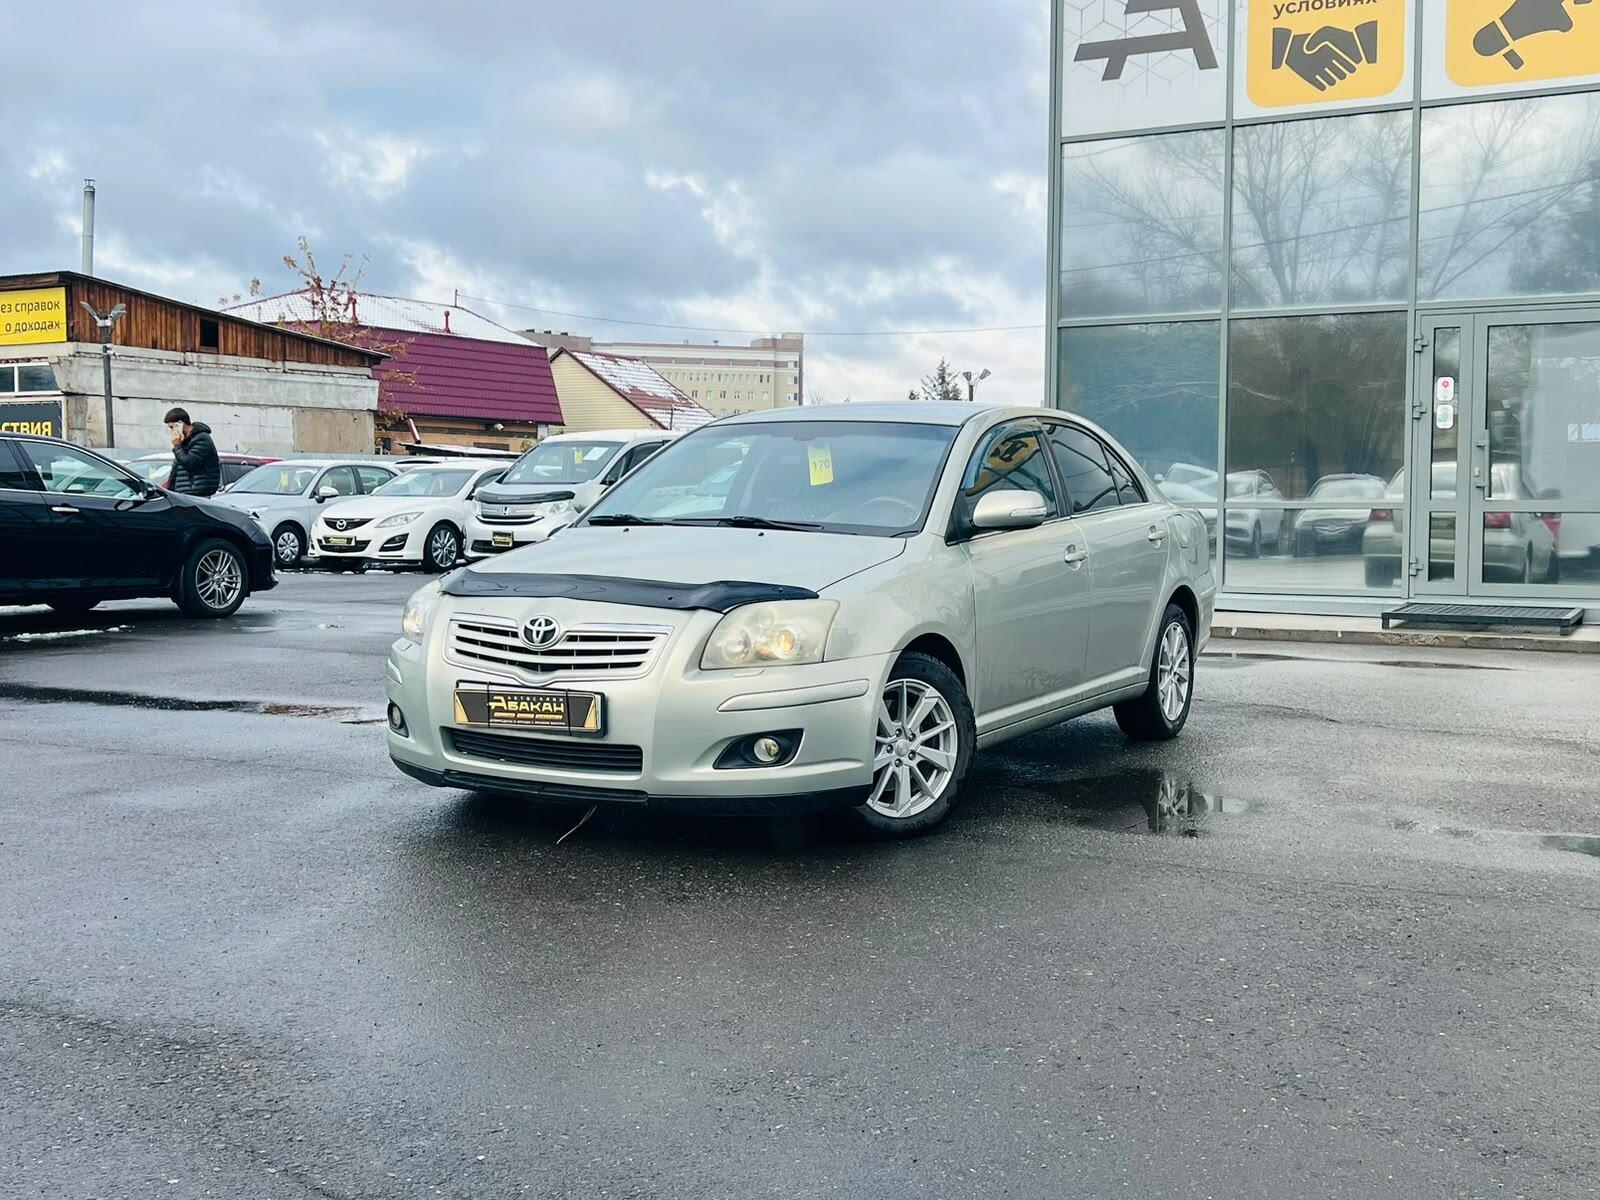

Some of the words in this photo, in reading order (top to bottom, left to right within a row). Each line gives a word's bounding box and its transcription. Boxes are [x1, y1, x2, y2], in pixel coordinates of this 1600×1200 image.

[15, 300, 60, 315] справок
[5, 323, 12, 332] о
[14, 320, 60, 334] доходах
[812, 458, 831, 470] 170
